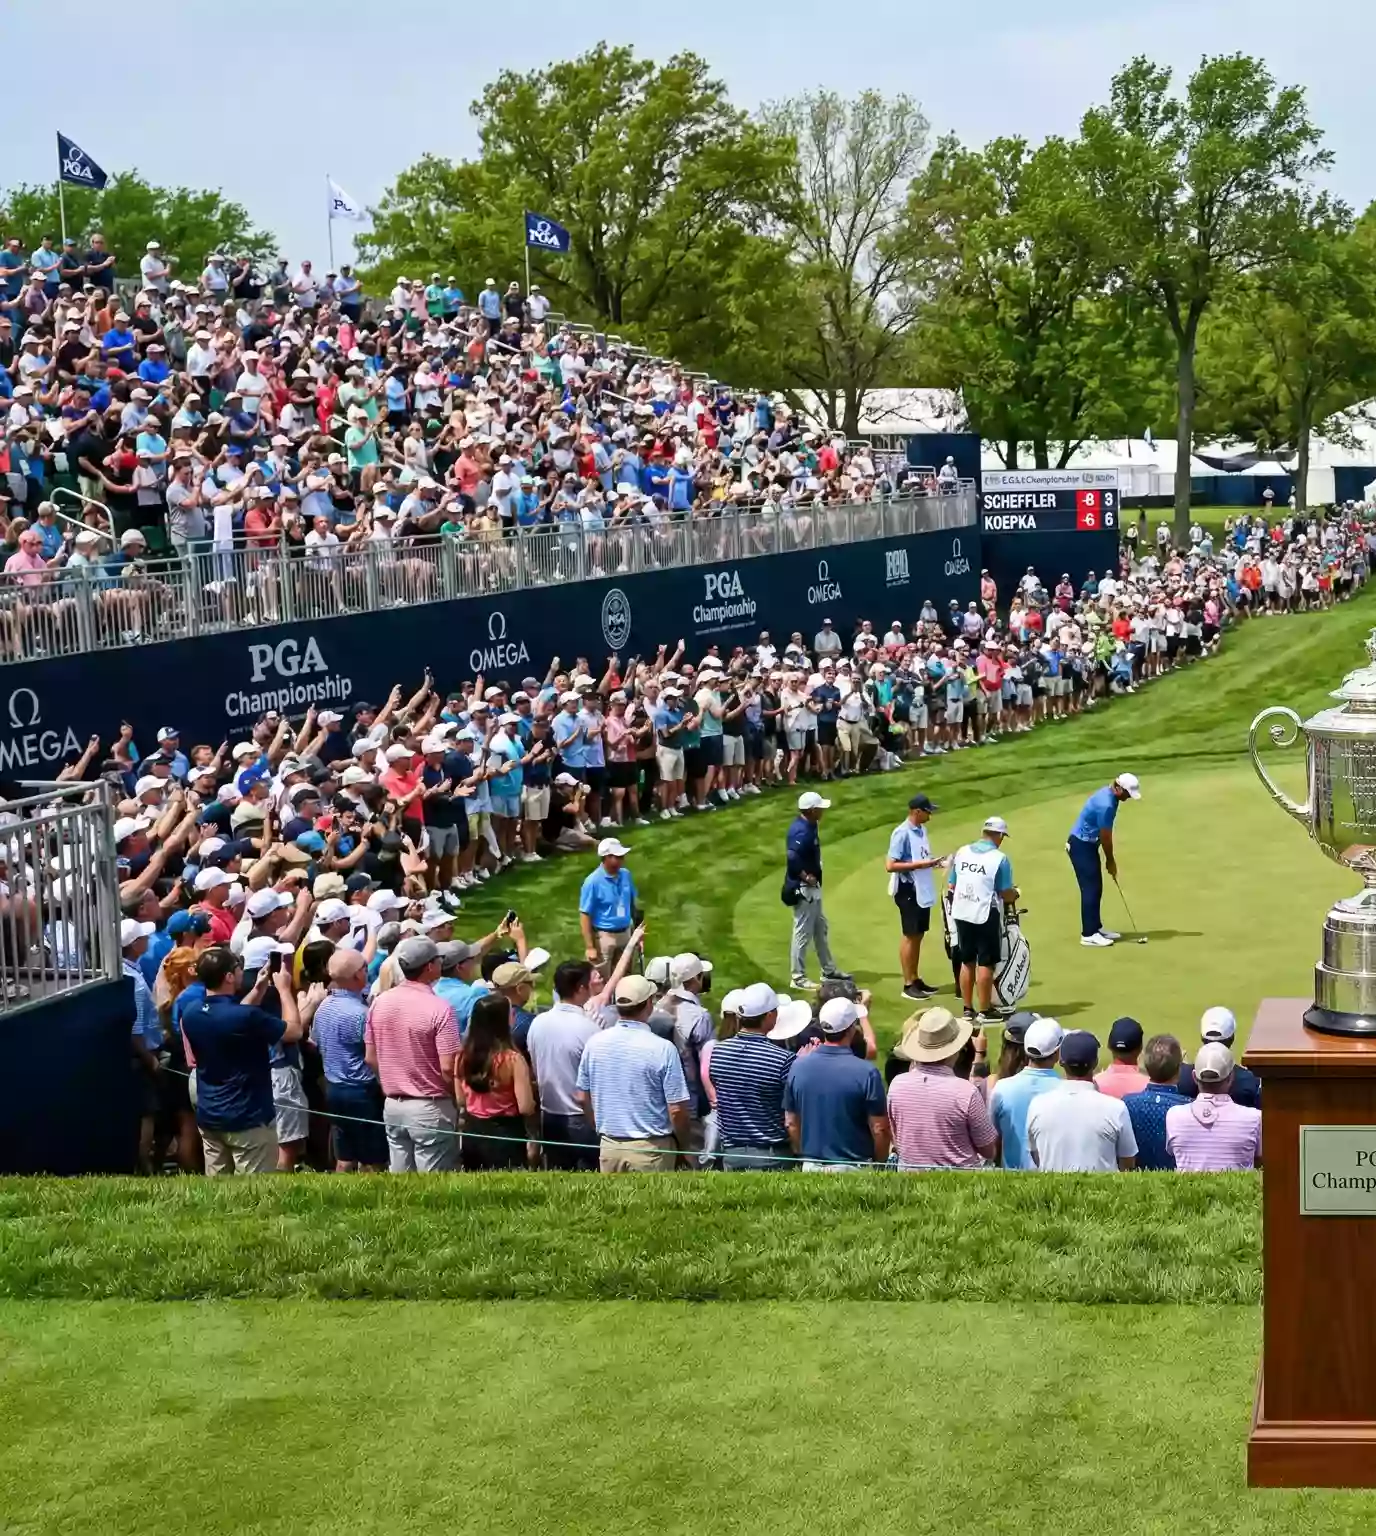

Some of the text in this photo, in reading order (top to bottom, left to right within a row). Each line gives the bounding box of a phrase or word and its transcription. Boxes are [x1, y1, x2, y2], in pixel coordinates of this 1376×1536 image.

[983, 492, 1113, 509] SCHEFFLER -8 3
[984, 512, 1114, 530] KOEPKA -6 6
[703, 570, 745, 600] PGA
[807, 582, 843, 604] OMEGA
[248, 636, 329, 682] PGA
[469, 640, 531, 673] OMEGA
[225, 674, 352, 717] Championship
[0, 726, 83, 771] MEGA
[960, 861, 987, 876] PGA
